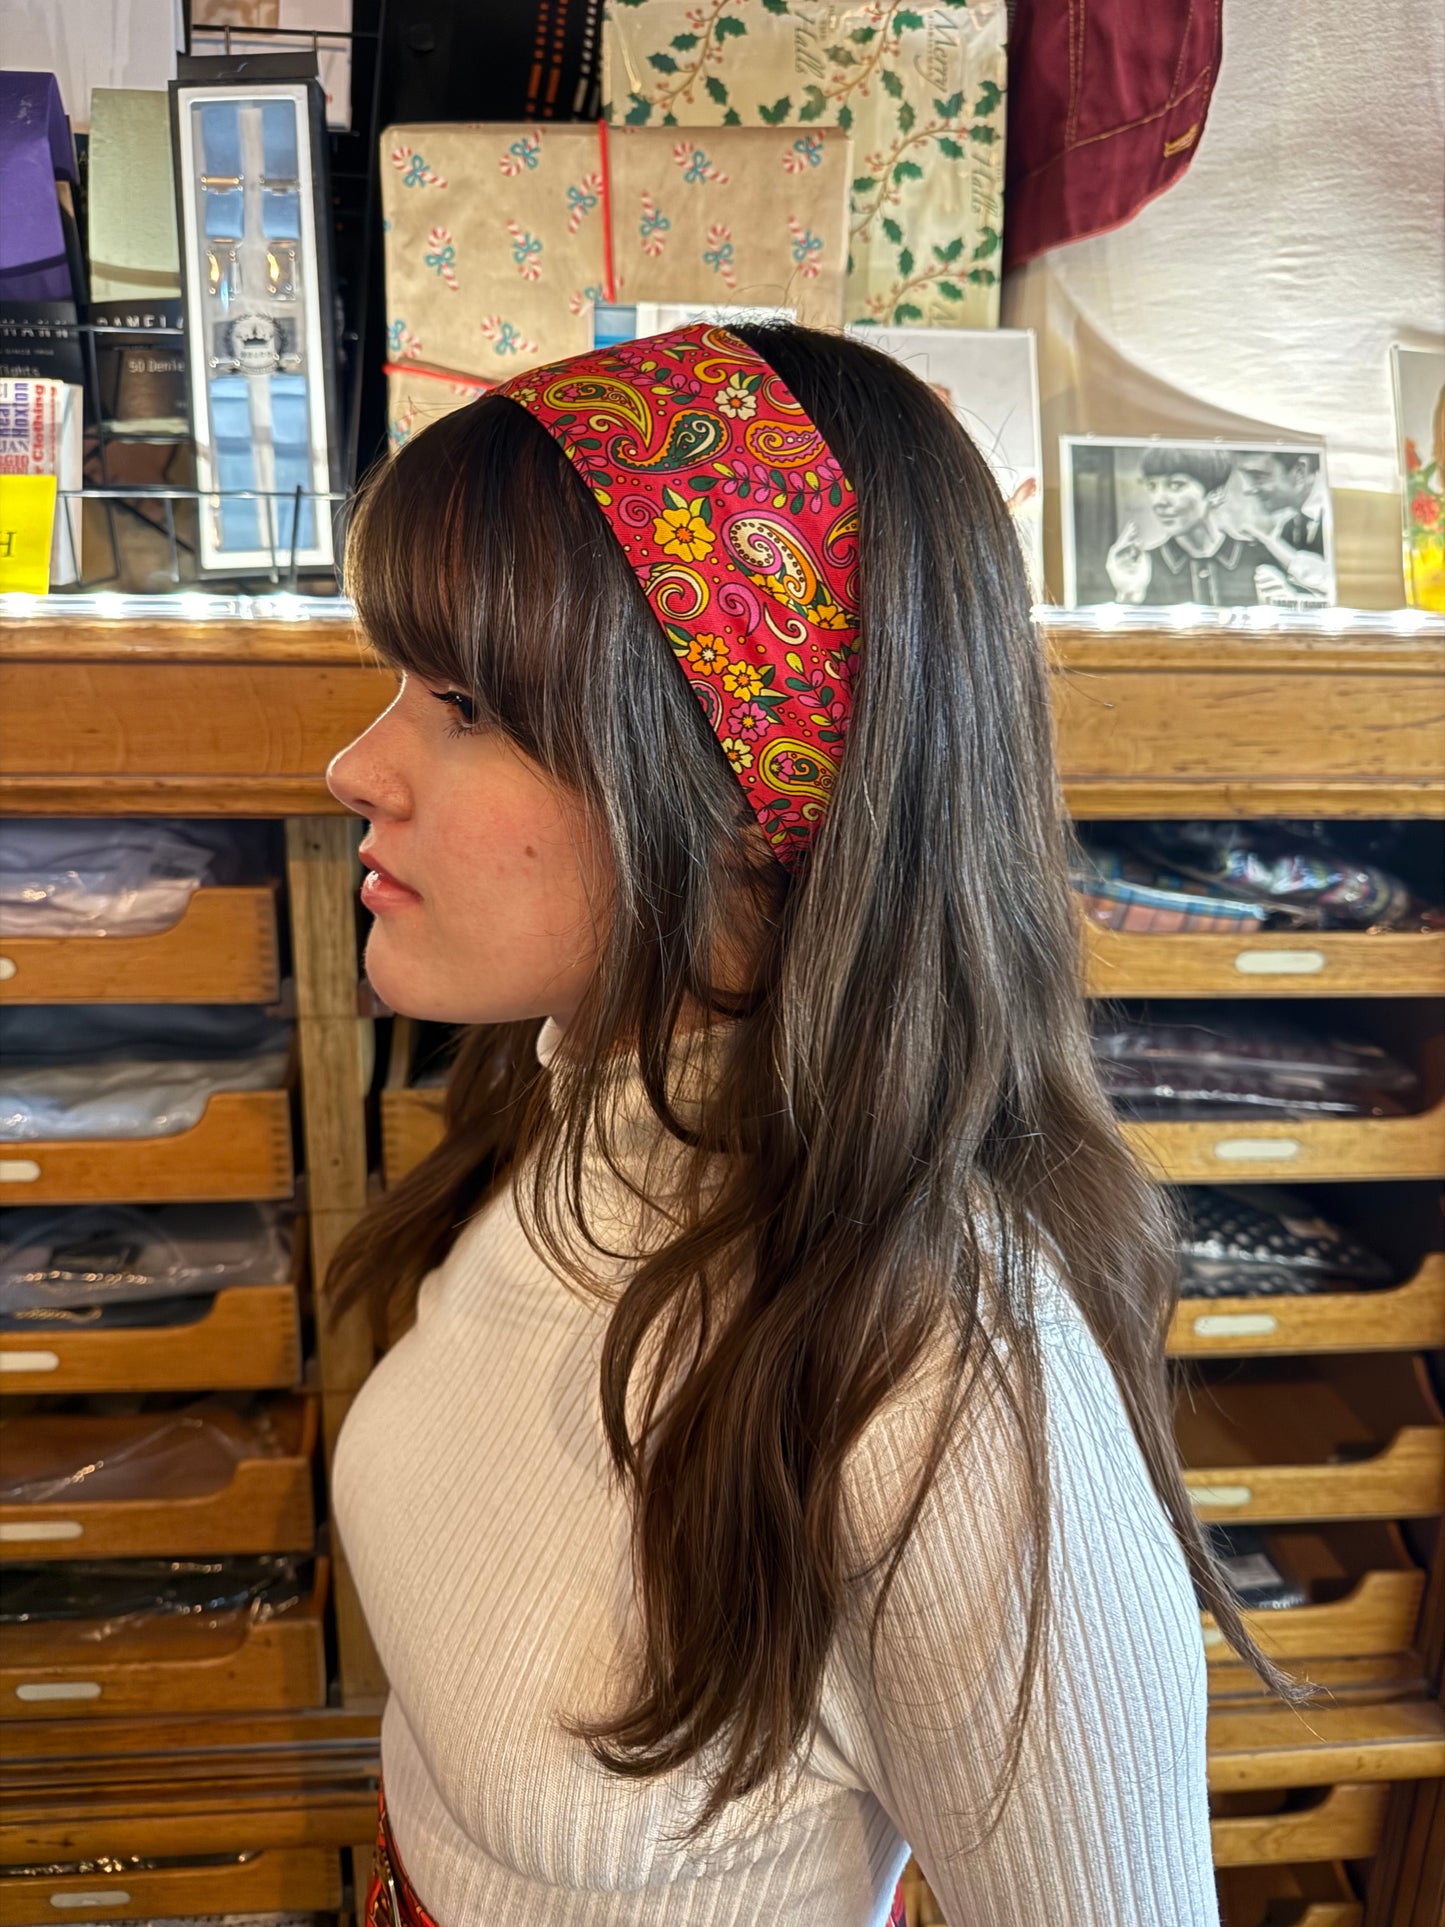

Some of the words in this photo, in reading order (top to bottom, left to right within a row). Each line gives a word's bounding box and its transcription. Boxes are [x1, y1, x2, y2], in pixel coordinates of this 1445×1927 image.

[913, 11, 958, 93] Merry
[128, 359, 145, 374] 50
[148, 358, 185, 374] Denie
[12, 383, 29, 438] Hoxton
[32, 384, 46, 462] Clothing
